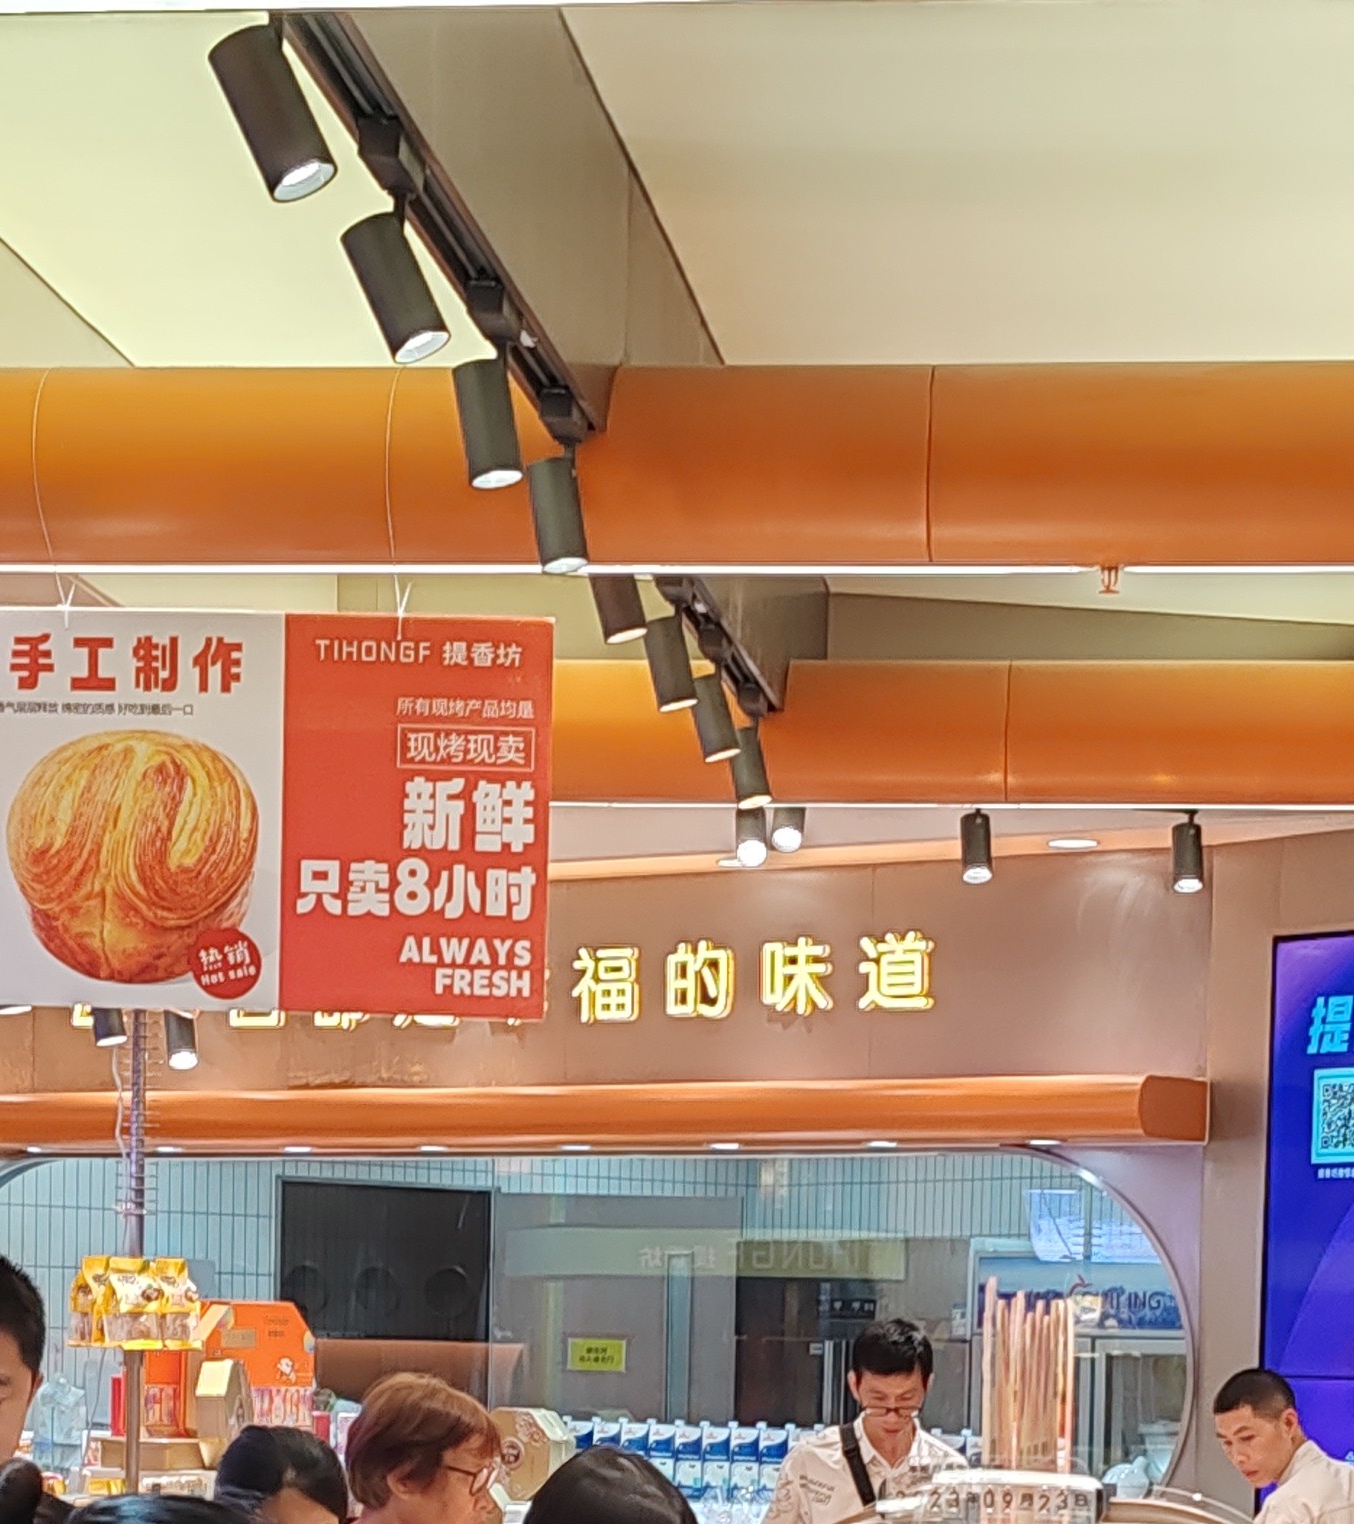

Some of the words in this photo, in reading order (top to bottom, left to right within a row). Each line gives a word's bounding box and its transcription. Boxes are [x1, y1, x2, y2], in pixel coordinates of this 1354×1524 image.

[315, 638, 431, 664] TIHONGF
[441, 640, 523, 668] 提香坊
[396, 696, 535, 720] 所有现烤产品均是
[406, 730, 526, 765] 现烤现卖
[402, 775, 536, 853] 新鲜
[295, 856, 537, 921] 只卖8小时
[197, 940, 252, 971] 热销
[398, 935, 533, 967] ALWAYS
[199, 972, 226, 987] Hot
[433, 967, 531, 998] FRESH
